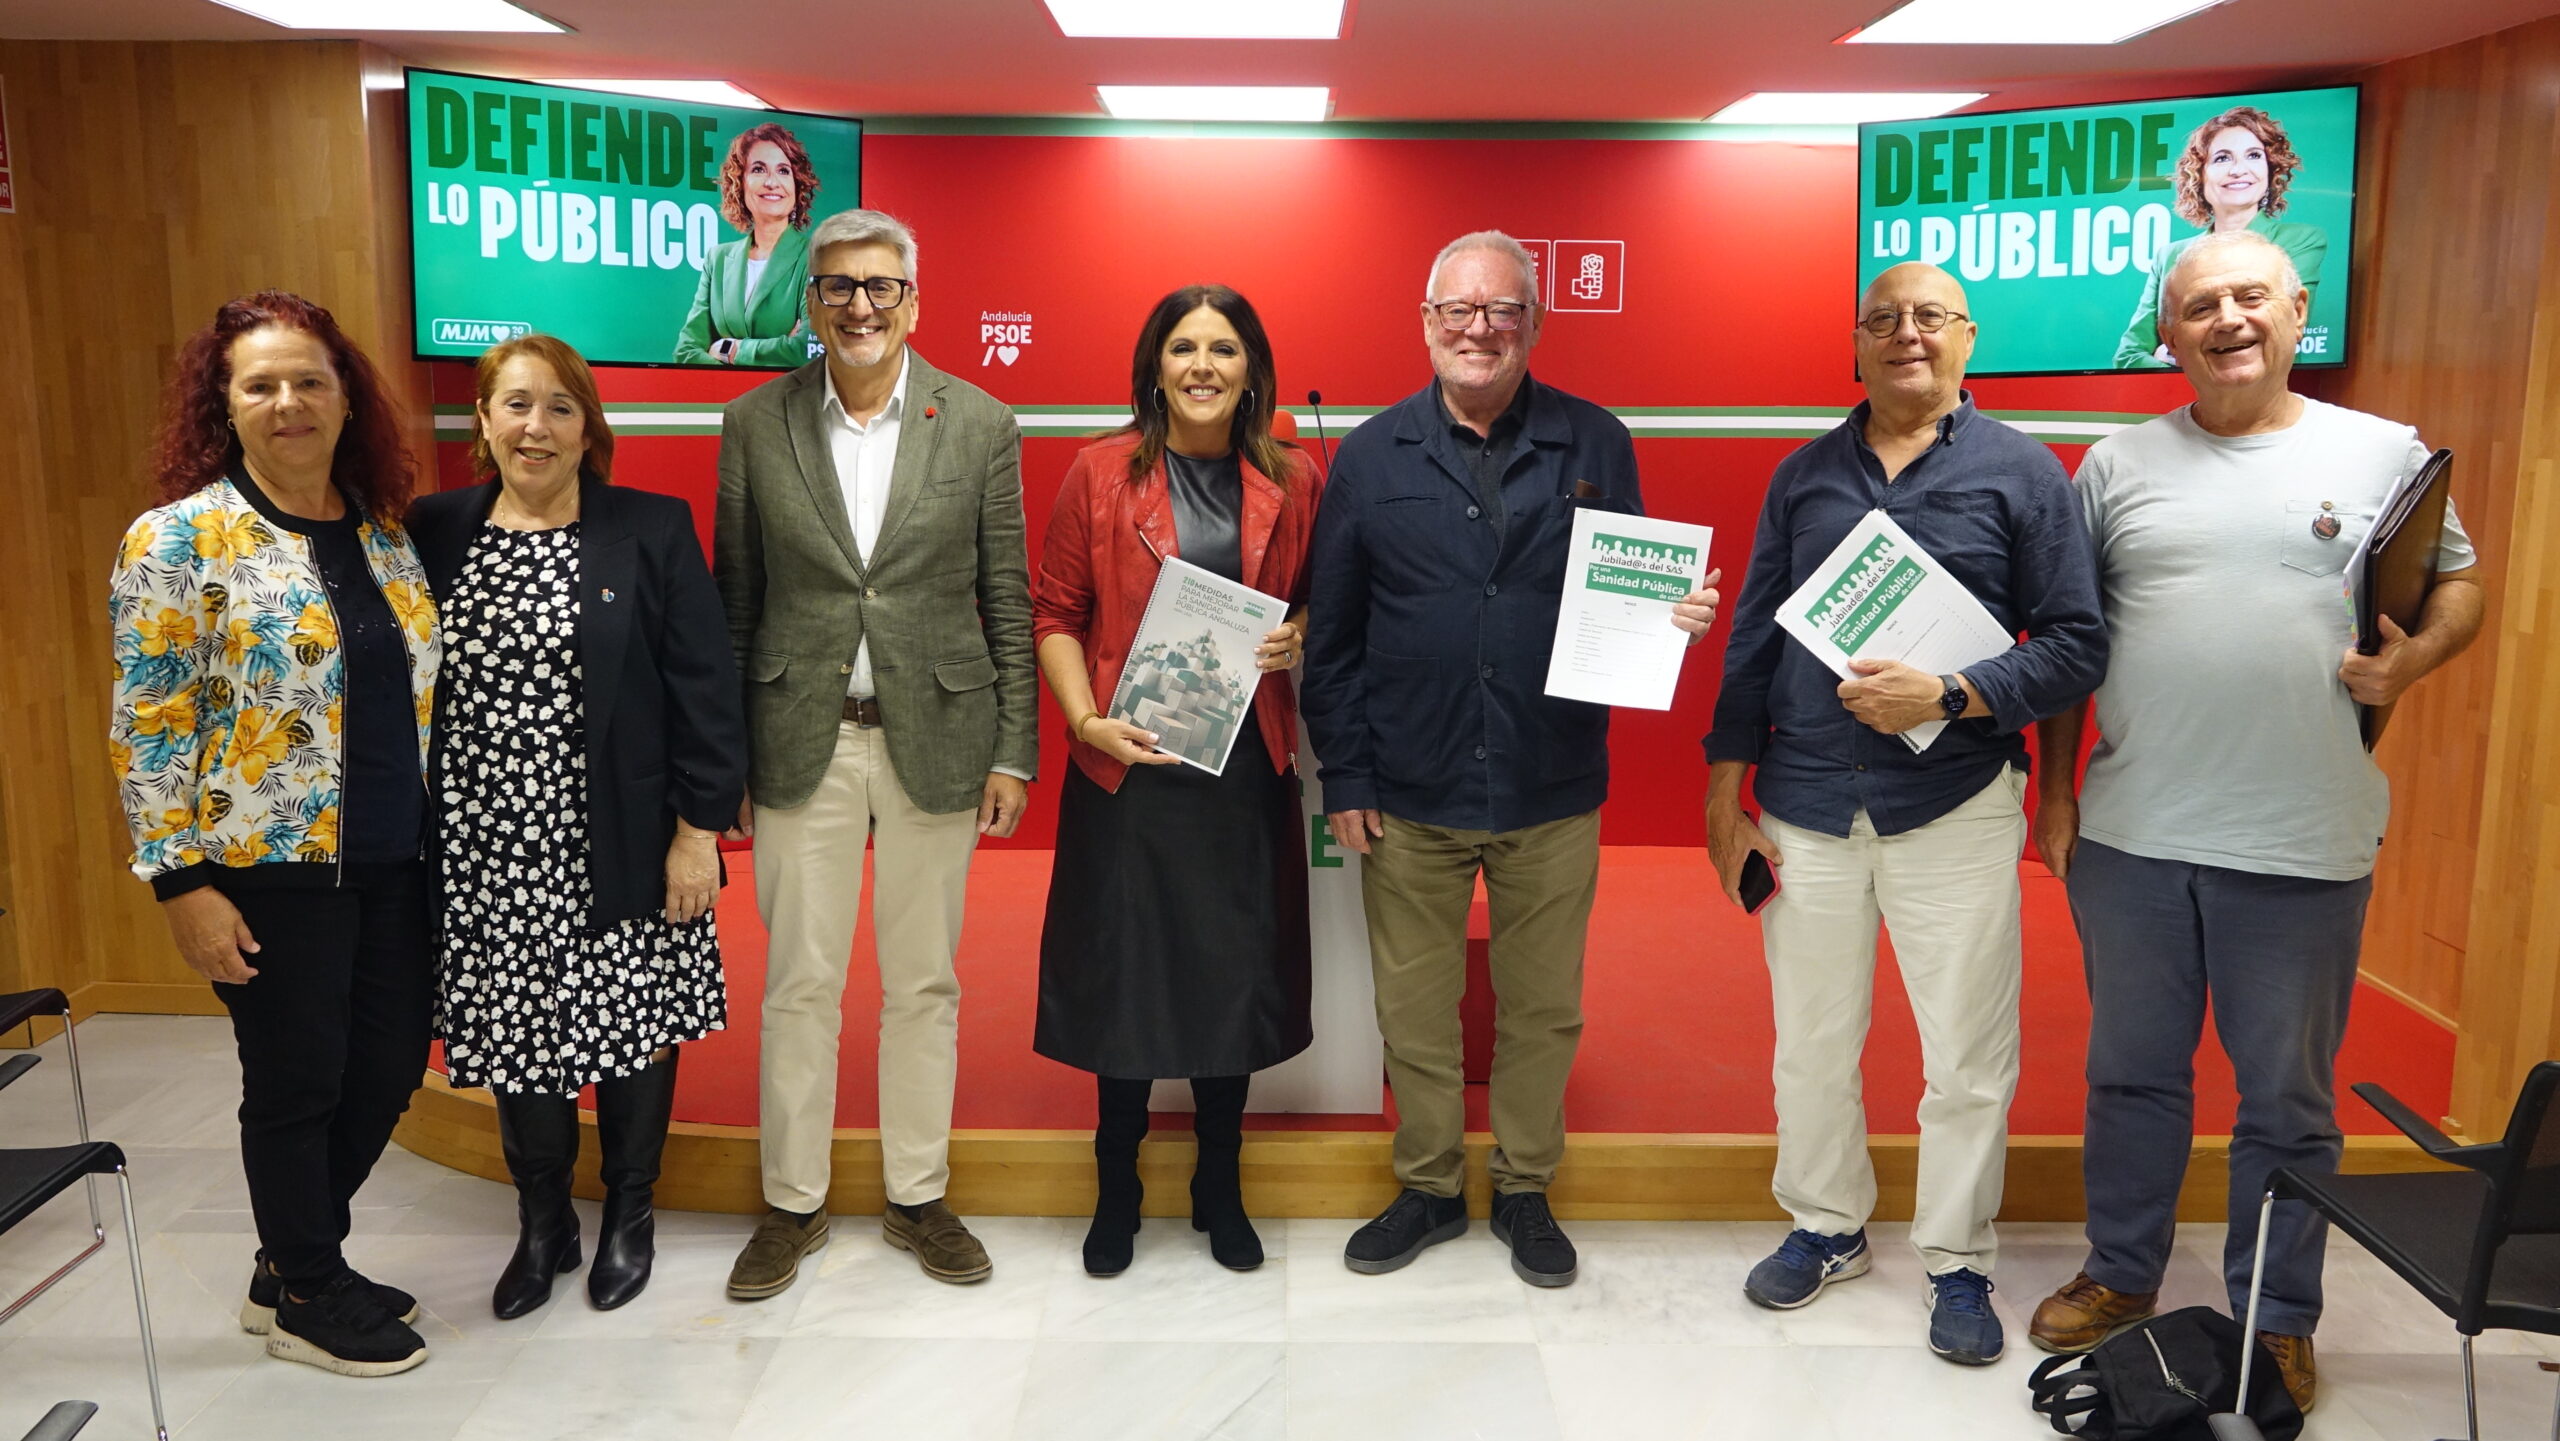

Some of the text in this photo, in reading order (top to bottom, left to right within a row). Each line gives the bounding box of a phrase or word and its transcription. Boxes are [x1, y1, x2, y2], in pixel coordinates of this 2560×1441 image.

[426, 85, 718, 192] DEFIENDE
[1875, 112, 2175, 207] DEFIENDE
[428, 179, 719, 271] LO PÚBLICO
[1874, 203, 2171, 282] LO PÚBLICO
[981, 310, 1032, 322] Andalucía
[440, 323, 490, 342] MJM
[981, 324, 1032, 344] PSOE
[1600, 555, 1647, 569] Jubilad@s
[1649, 563, 1664, 572] del
[1194, 582, 1234, 602] MEDIDAS
[1592, 571, 1685, 595] Sanidad Pública
[1178, 592, 1188, 601] LA
[1189, 595, 1224, 615] SANIDAD
[1181, 584, 1201, 597] PARA
[1202, 593, 1240, 613] MEJORAR
[1830, 588, 1868, 628] Jubilad@s
[1867, 572, 1880, 588] del
[1840, 567, 1916, 647] Sanidad Pública
[1208, 613, 1250, 634] ANDALUZA
